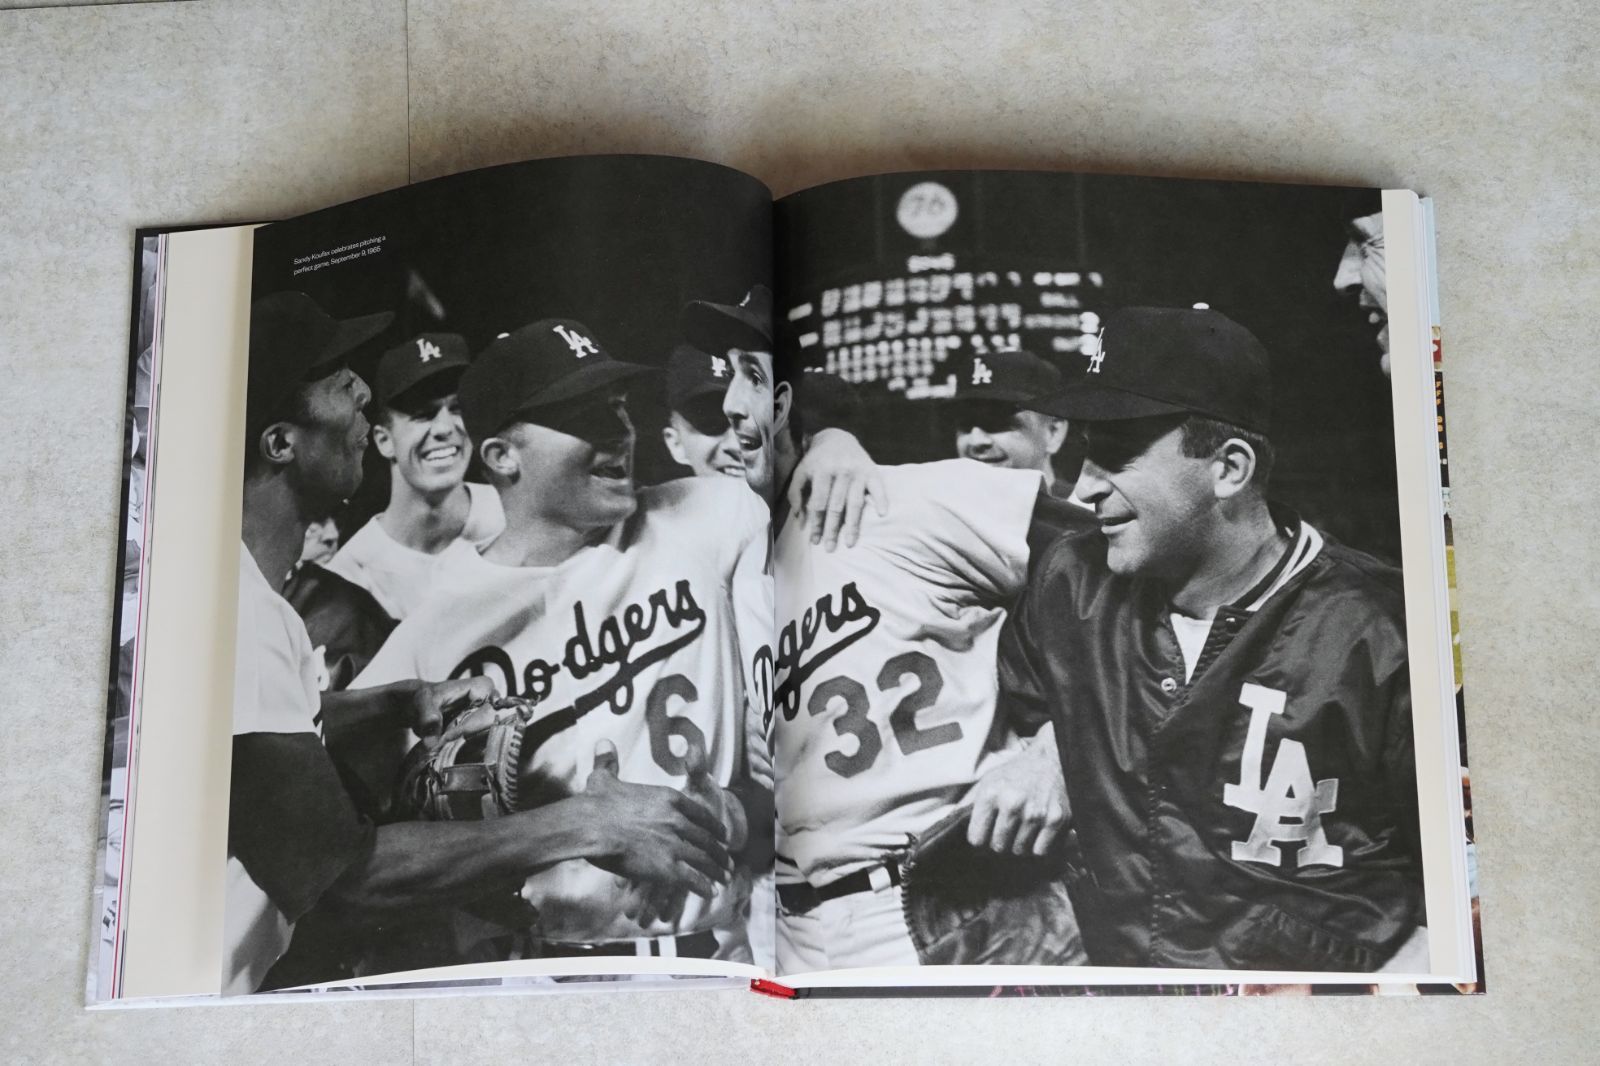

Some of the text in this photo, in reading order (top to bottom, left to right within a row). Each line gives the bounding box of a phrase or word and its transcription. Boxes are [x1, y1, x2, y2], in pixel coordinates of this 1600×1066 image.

[293, 256, 311, 265] Sandy
[311, 250, 330, 260] Koufax
[331, 242, 359, 255] celebrates
[293, 265, 313, 276] perfect
[646, 673, 707, 777] 6
[807, 650, 964, 779] 32
[1222, 682, 1344, 868] LA
